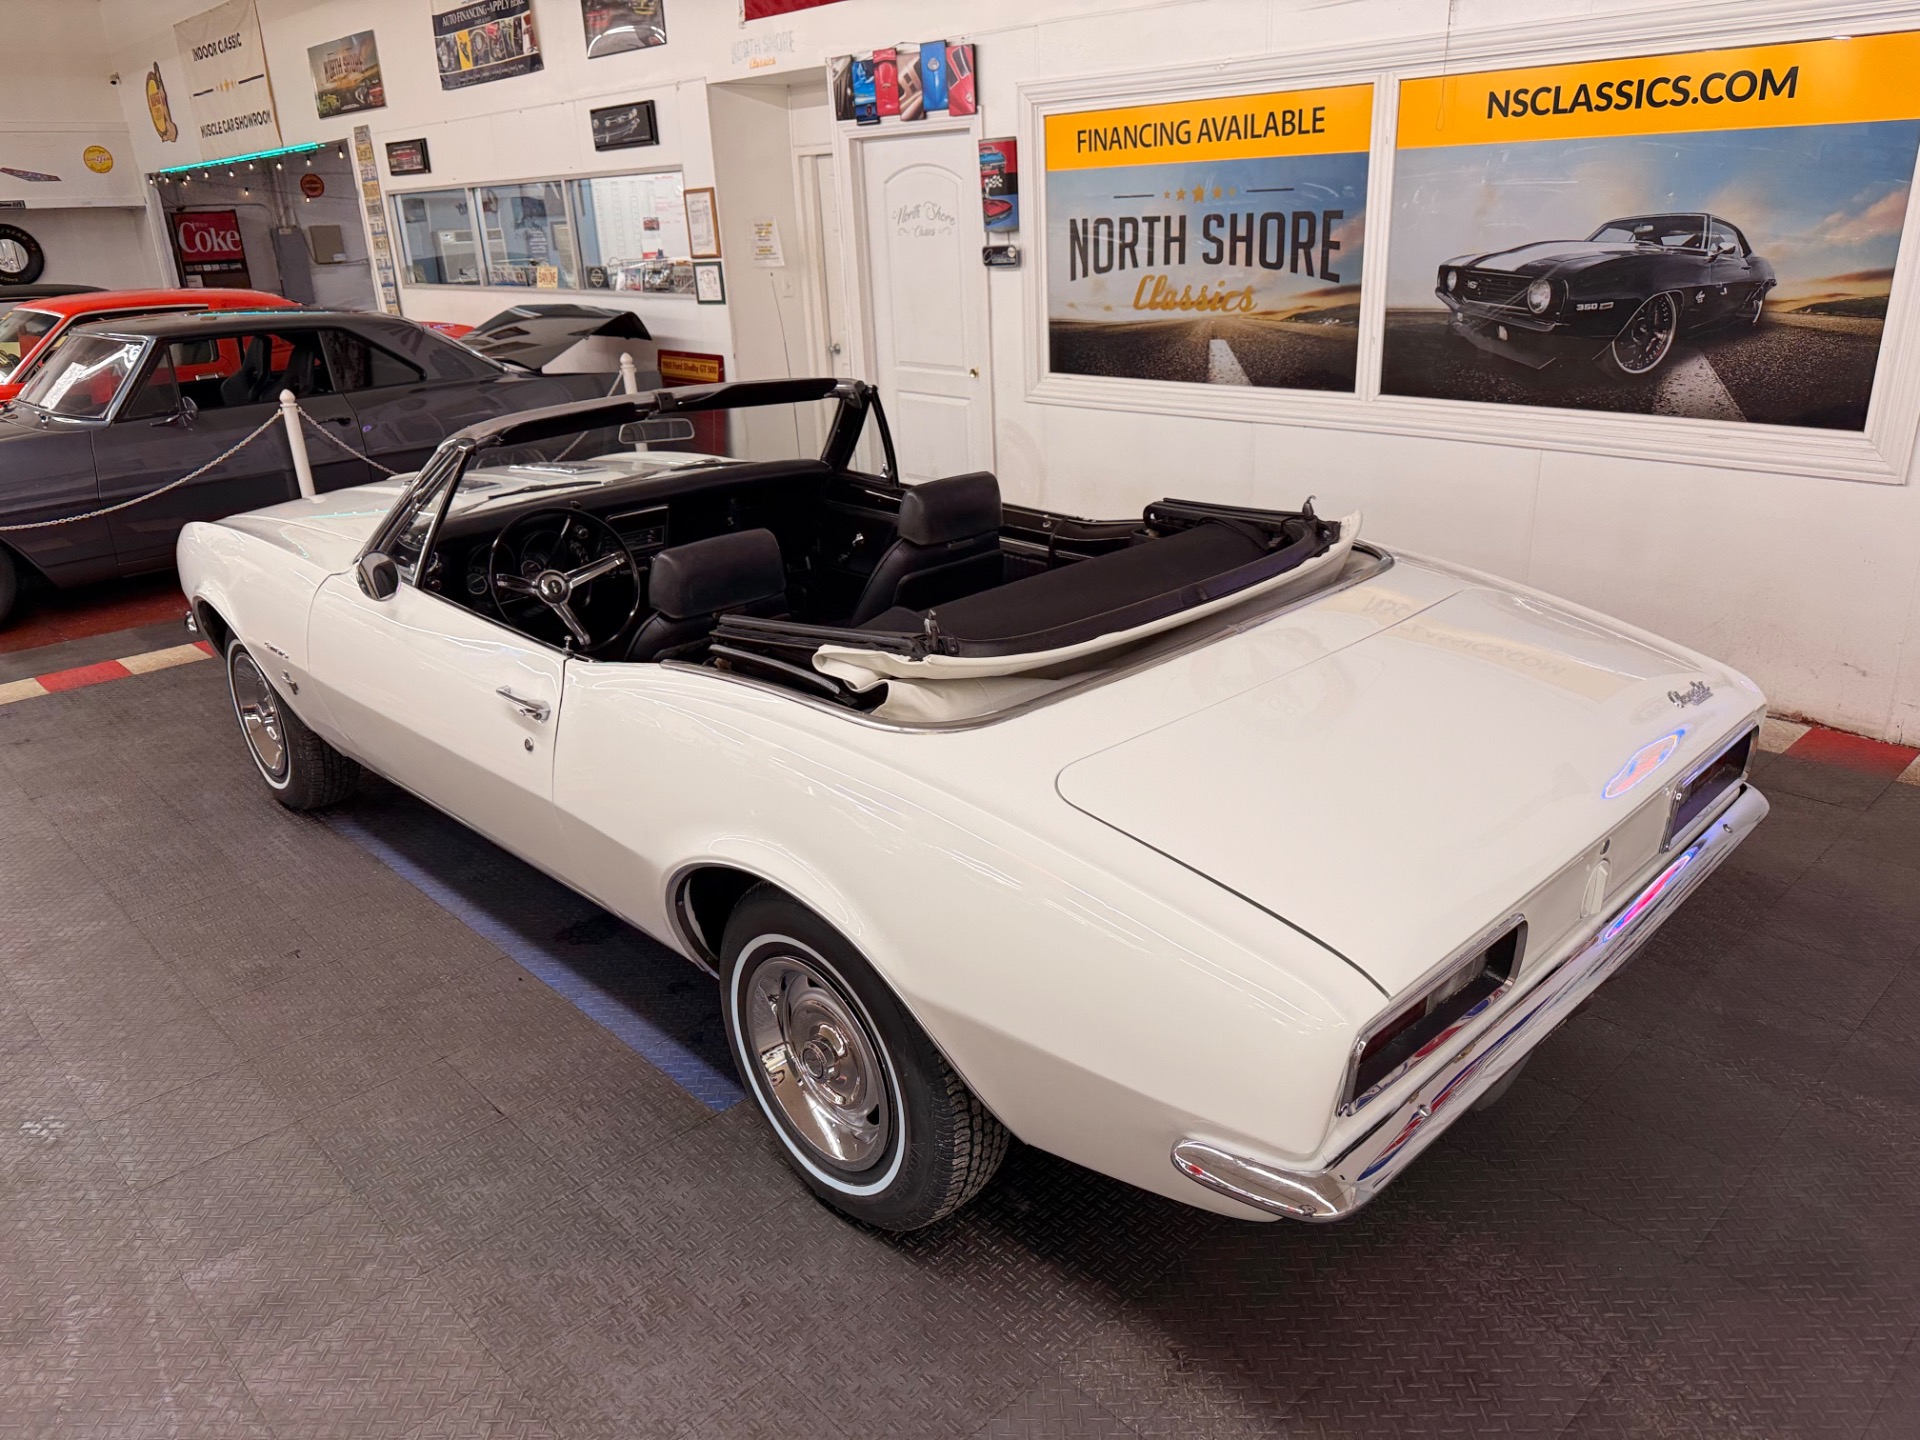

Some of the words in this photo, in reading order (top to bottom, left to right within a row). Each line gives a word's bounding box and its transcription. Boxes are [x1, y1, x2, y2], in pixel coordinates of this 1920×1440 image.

[191, 42, 218, 61] INDOOR
[217, 32, 242, 53] CLASSIC
[1486, 66, 1800, 120] NSCLASSICS.COM
[200, 121, 223, 138] MUSCLE
[222, 118, 235, 133] CAR
[234, 109, 273, 130] SHOWROOM
[1077, 119, 1192, 154] FINANCING
[1196, 106, 1326, 144] AVAILABLE
[892, 203, 922, 225] North
[922, 200, 956, 226] Shore
[178, 222, 242, 252] Coke
[1069, 214, 1187, 282] NORTH
[1202, 209, 1344, 284] SHORE
[1132, 274, 1257, 312] Classics
[1576, 302, 1598, 311] 350
